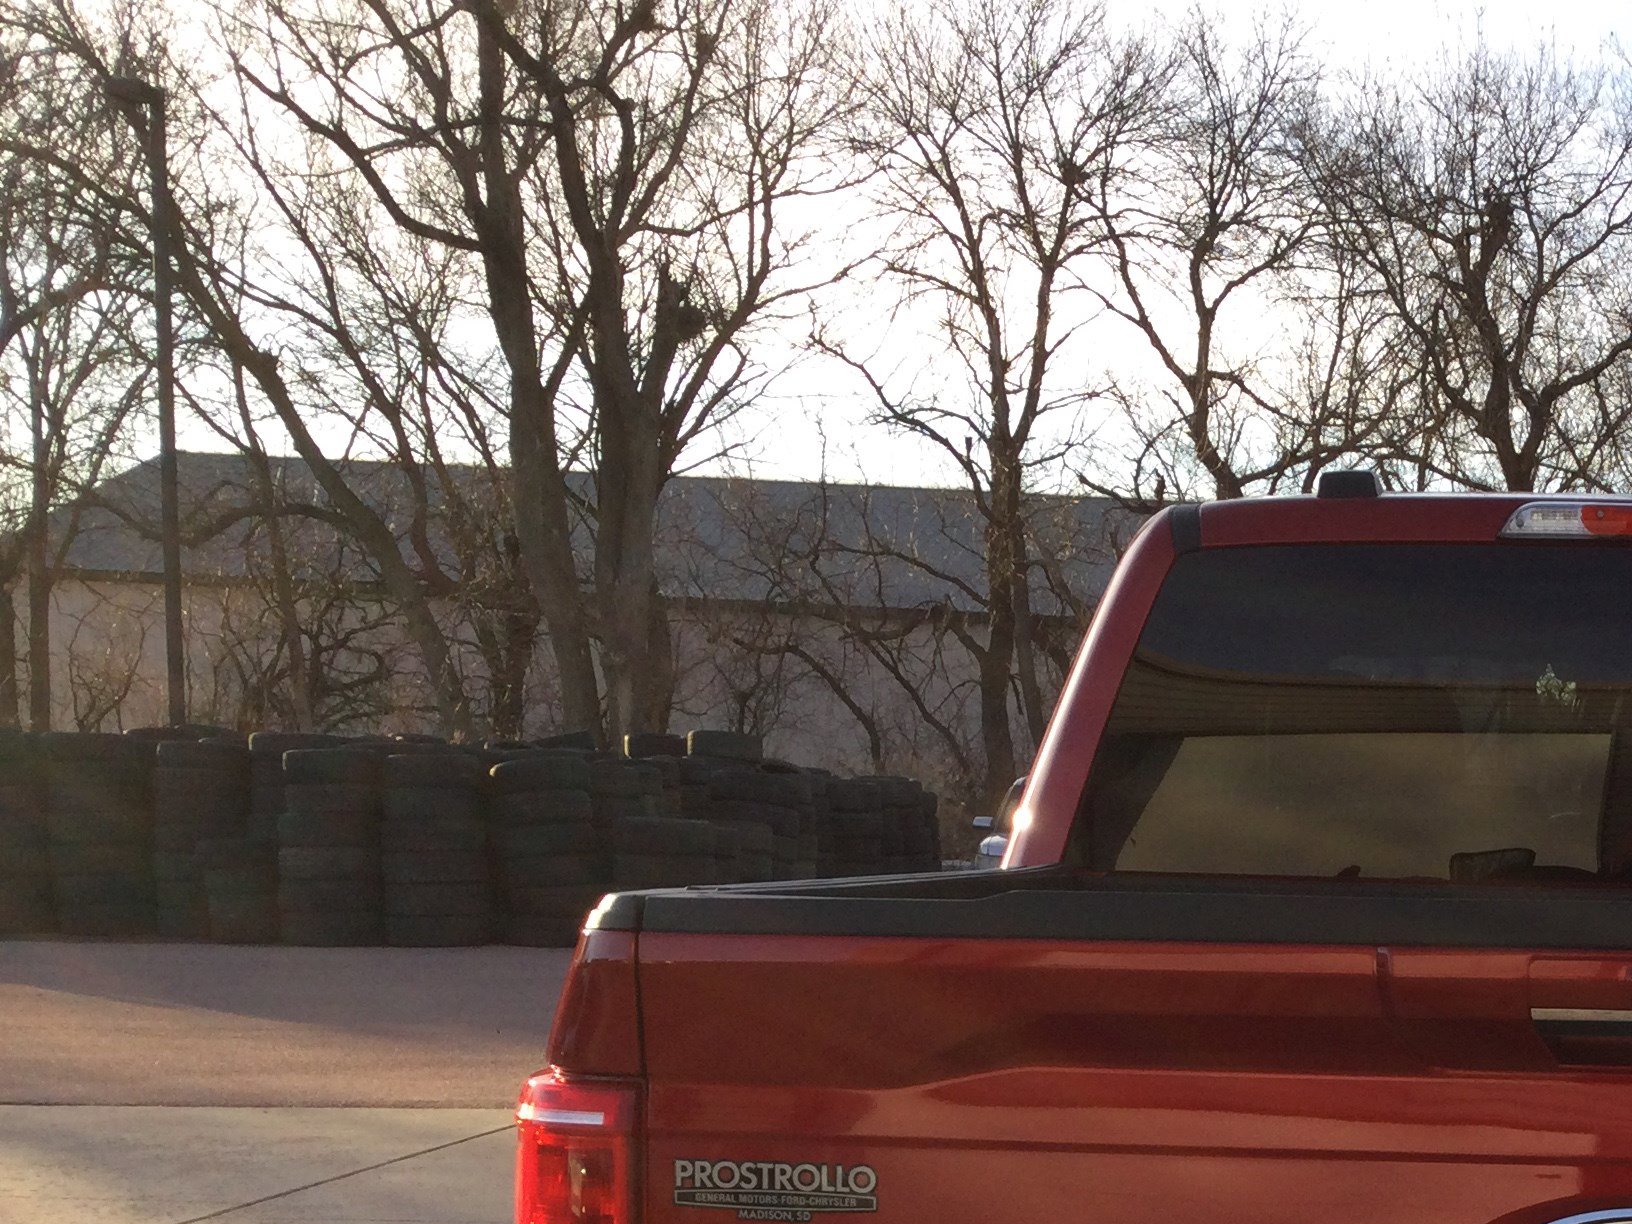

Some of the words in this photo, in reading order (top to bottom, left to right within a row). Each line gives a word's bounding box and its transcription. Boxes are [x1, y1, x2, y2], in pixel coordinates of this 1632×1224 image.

[675, 1159, 877, 1194] PROSTROLLO
[695, 1192, 735, 1203] GENERAL
[738, 1209, 794, 1221] MADISON,
[796, 1211, 811, 1221] SD
